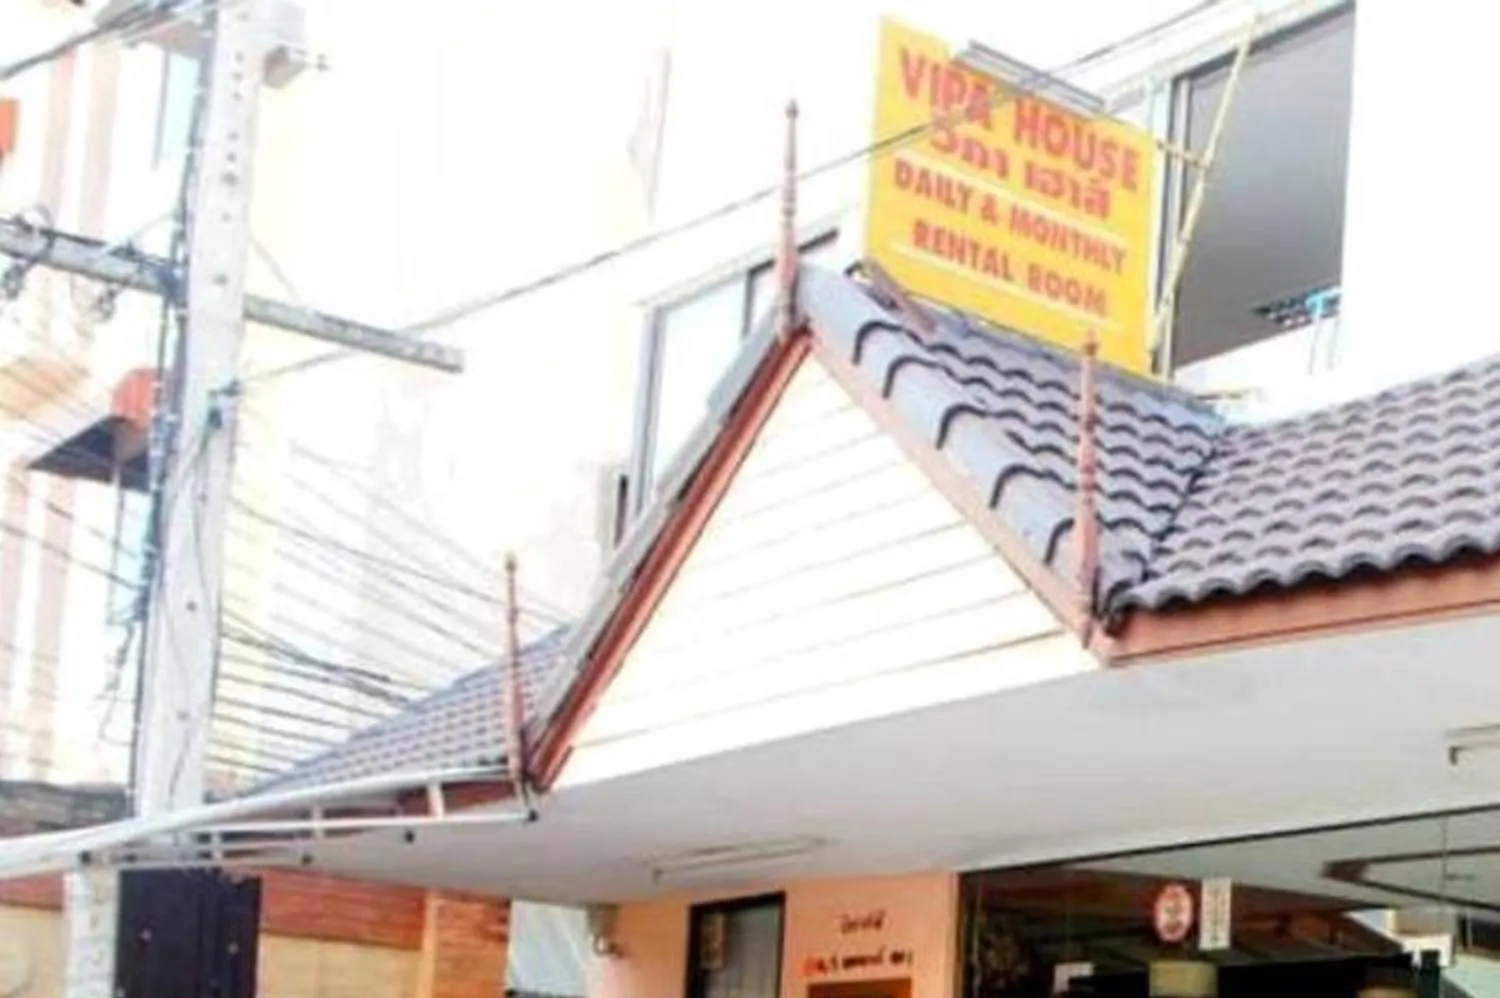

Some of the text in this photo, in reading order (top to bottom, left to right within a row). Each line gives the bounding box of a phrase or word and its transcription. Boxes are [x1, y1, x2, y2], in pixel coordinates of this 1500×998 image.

[901, 47, 1141, 191] VIPA HOUSE
[894, 159, 972, 214] DAILY
[1009, 204, 1127, 275] MONTHLY
[912, 218, 1108, 316] RENTAL ROOM
